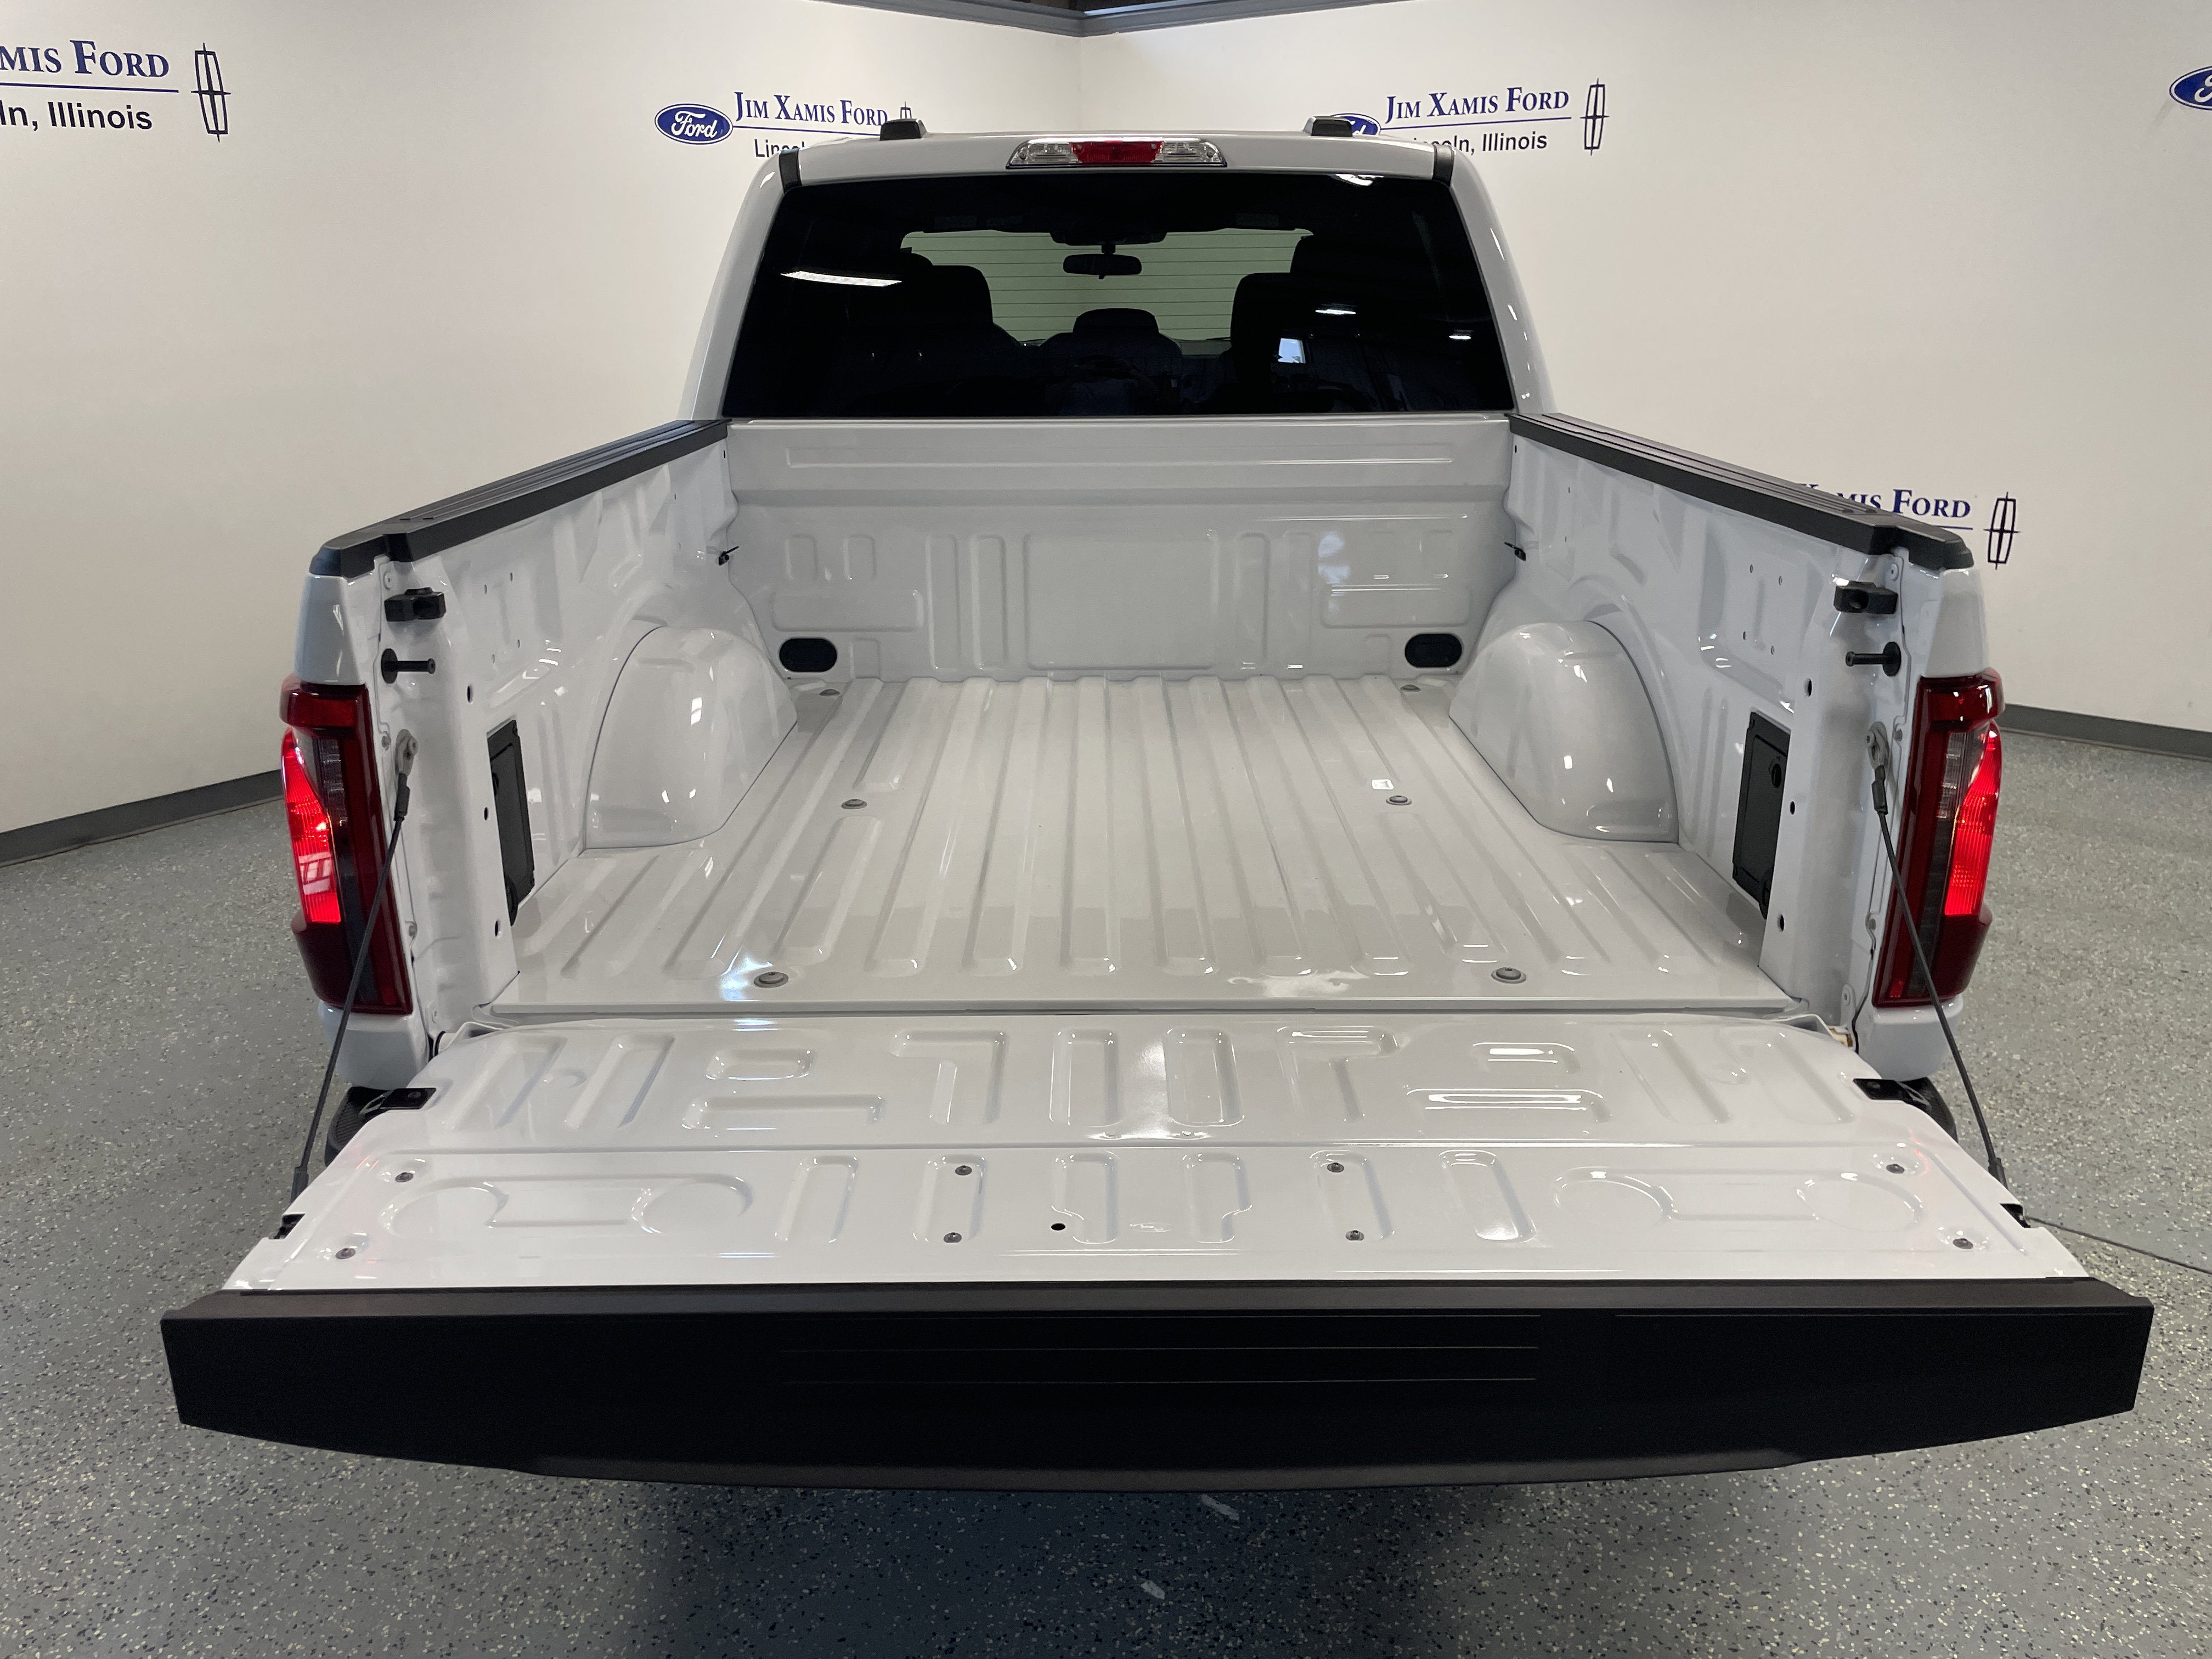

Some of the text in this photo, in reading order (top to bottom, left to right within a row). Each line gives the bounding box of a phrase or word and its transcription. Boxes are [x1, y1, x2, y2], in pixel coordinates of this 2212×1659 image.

[70, 40, 170, 77] FORD
[48, 101, 153, 130] Illinois
[734, 92, 888, 126] JIM XAMIS FORD
[1385, 87, 1570, 124] JIM XAMIS FORD
[671, 111, 718, 138] Ford
[1482, 131, 1548, 151] Illinois
[1893, 488, 1971, 518] FORD
